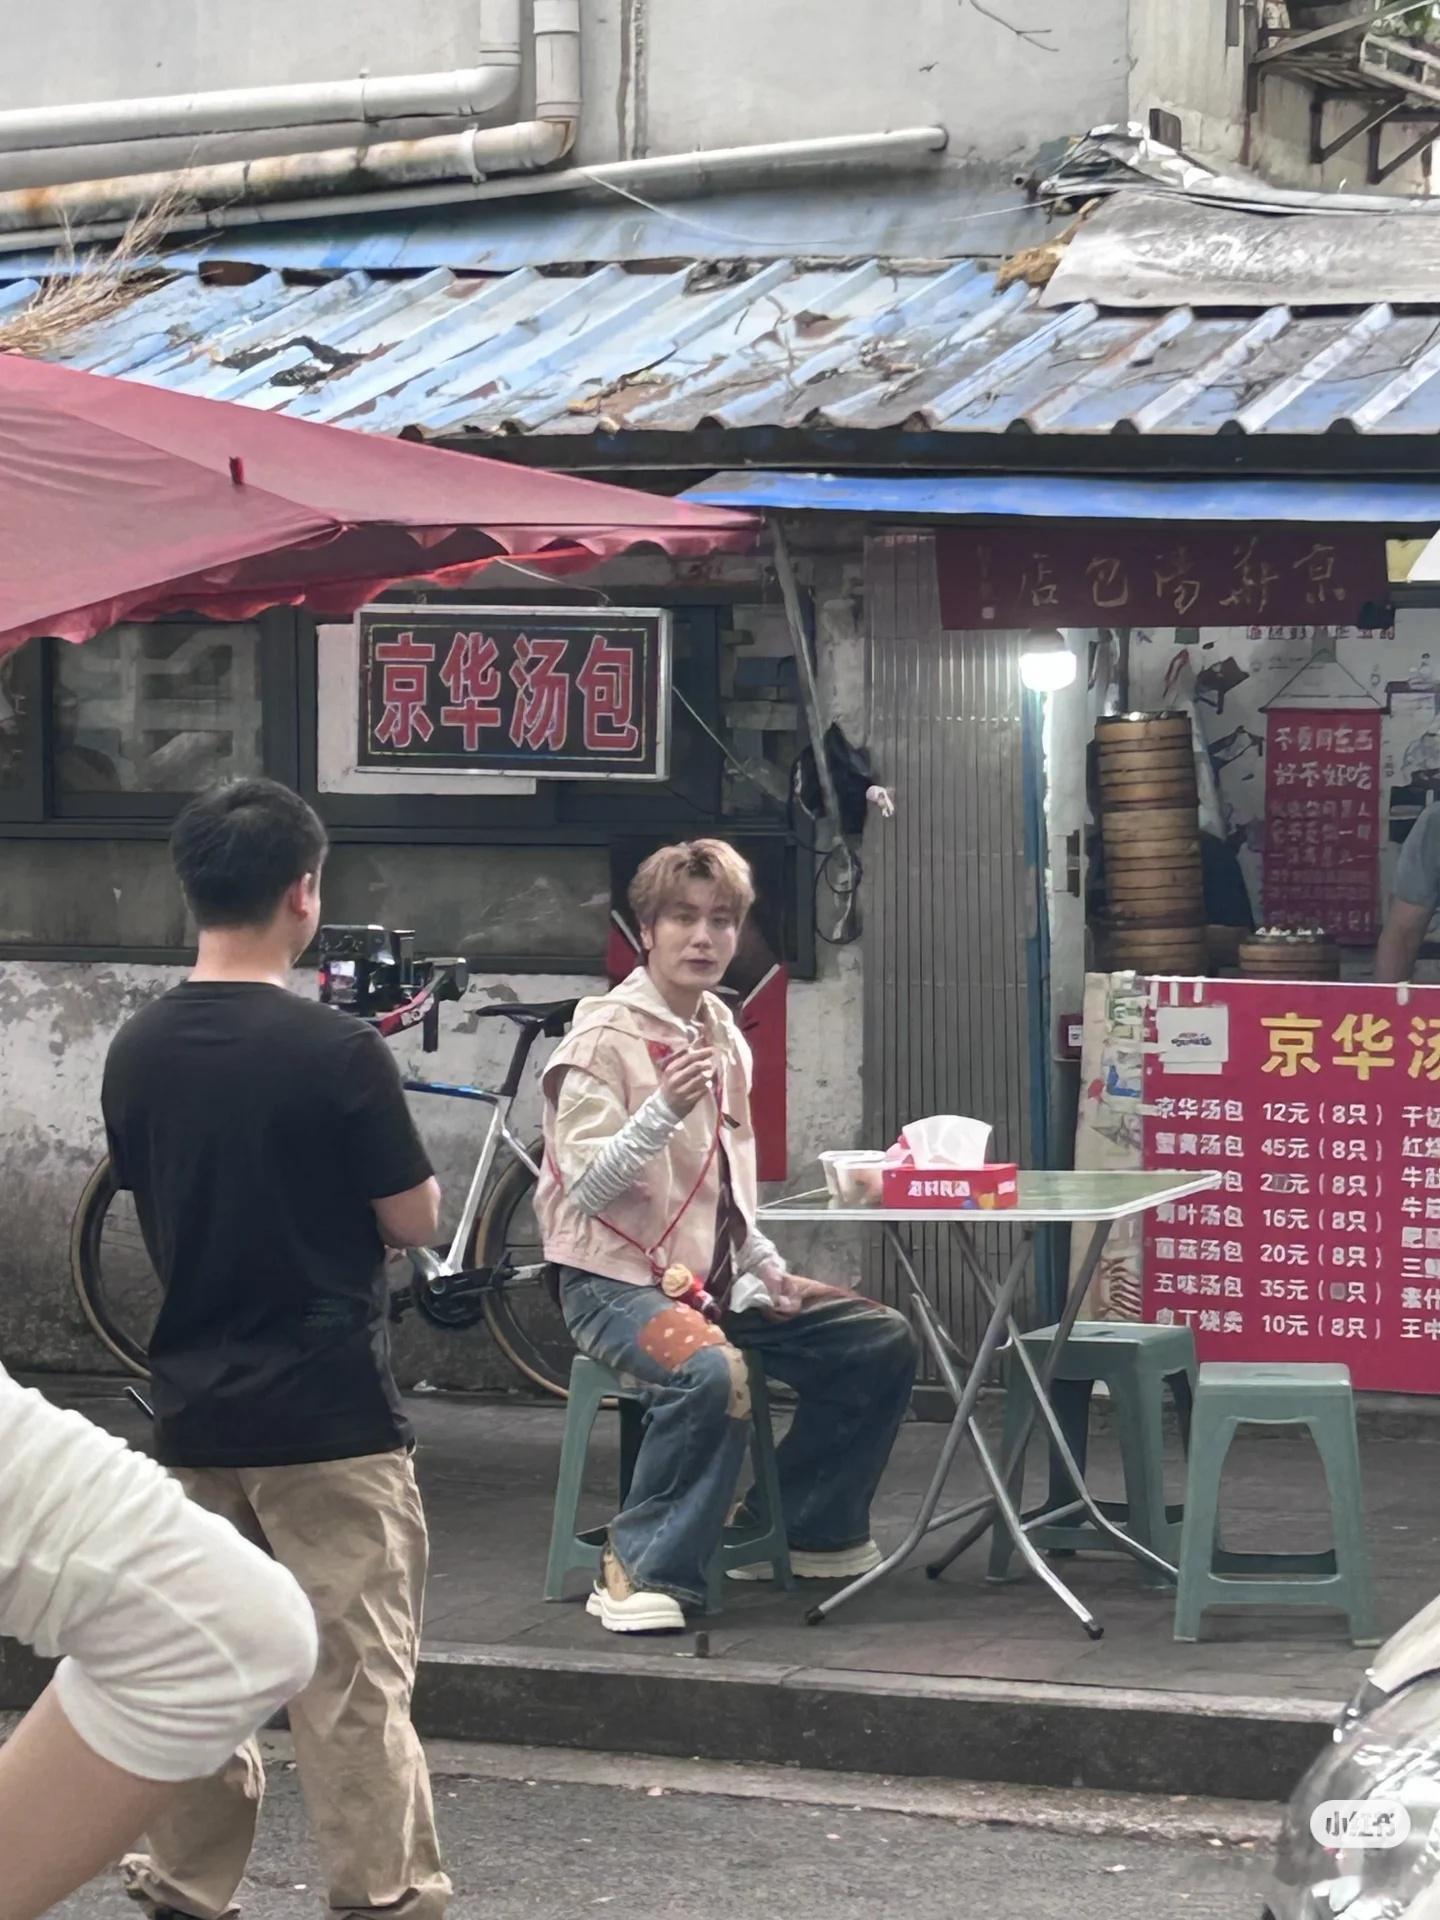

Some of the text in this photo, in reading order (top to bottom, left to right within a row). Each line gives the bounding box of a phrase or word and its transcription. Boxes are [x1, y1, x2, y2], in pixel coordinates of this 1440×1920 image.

[375, 632, 639, 751] 京华汤包
[1155, 1097, 1244, 1121] 京华汤包
[1260, 1173, 1382, 1197] 2元（8只）
[1153, 1272, 1382, 1305] 五味汤包 35元（只）
